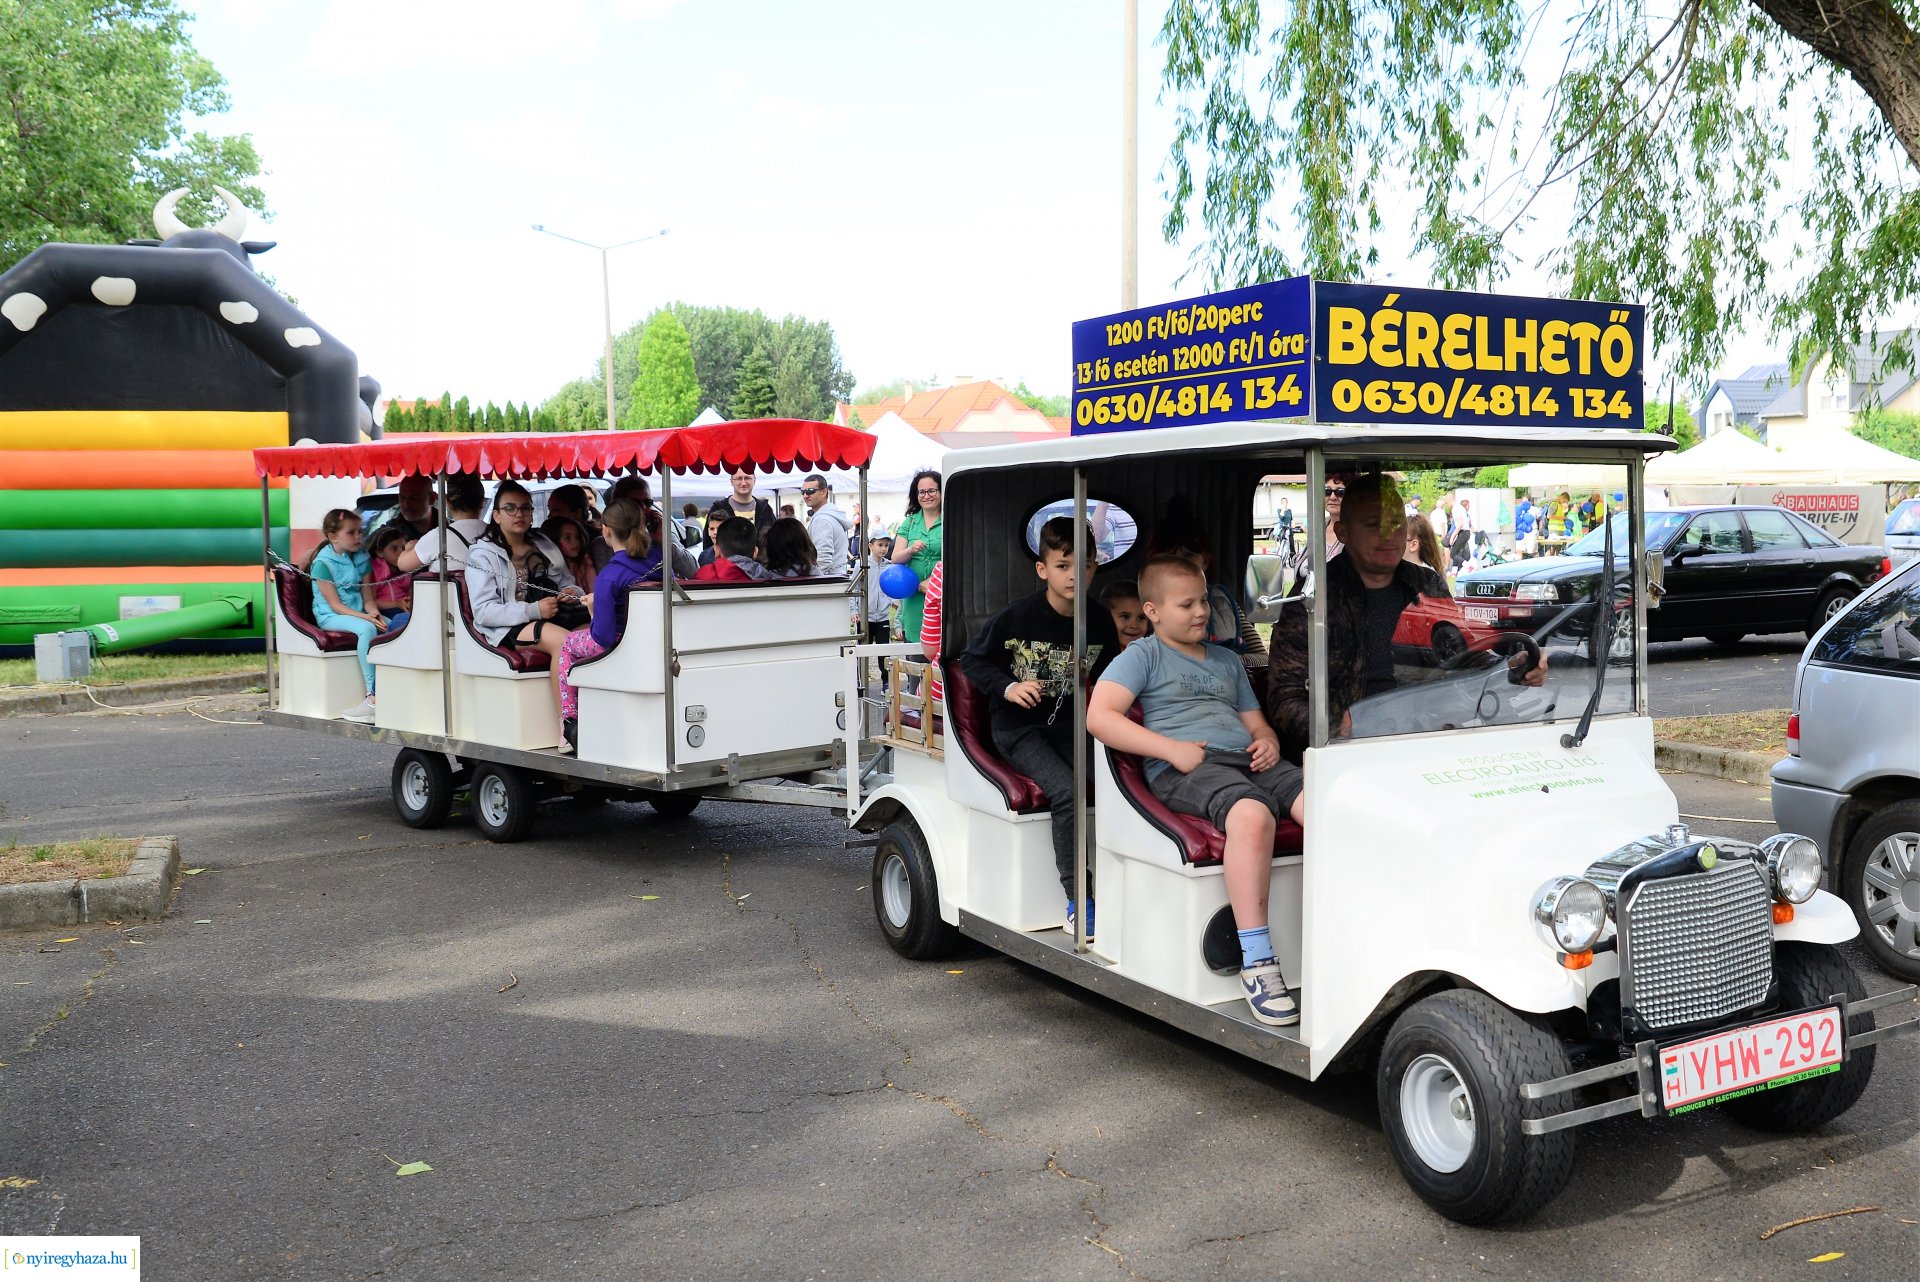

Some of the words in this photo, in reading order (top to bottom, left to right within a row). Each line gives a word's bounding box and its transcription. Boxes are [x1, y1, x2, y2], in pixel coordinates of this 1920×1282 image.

[1106, 319, 1143, 347] 1200
[1148, 301, 1263, 340] Ft/fő/20perc
[1328, 293, 1634, 378] BÉRELHETŐ
[1077, 362, 1091, 384] 13
[1095, 357, 1110, 382] fő
[1114, 350, 1168, 379] esetén
[1172, 341, 1224, 371] 12000
[1229, 331, 1263, 364] Ft/1
[1269, 330, 1304, 357] óra
[1076, 382, 1233, 426] 0630/4814
[1241, 374, 1303, 410] 134
[1331, 377, 1559, 419] 0630/4814
[1568, 387, 1633, 419] 134
[1786, 495, 1859, 510] BAUHAUS
[1180, 682, 1193, 690] THE
[1203, 675, 1214, 684] OF
[1422, 759, 1564, 785] ELECTROAUTO
[1567, 754, 1604, 768] Ltd.
[1458, 752, 1527, 767] PRODUCED
[1690, 1018, 1836, 1090] YHW-292
[1666, 1078, 1681, 1100] H
[1675, 1100, 1706, 1115] PRODUCED
[1707, 1098, 1715, 1106] BY
[1716, 1086, 1755, 1103] ELECTROAUTO
[1756, 1083, 1766, 1092] Ltd.
[1770, 1079, 1788, 1087] Phone:
